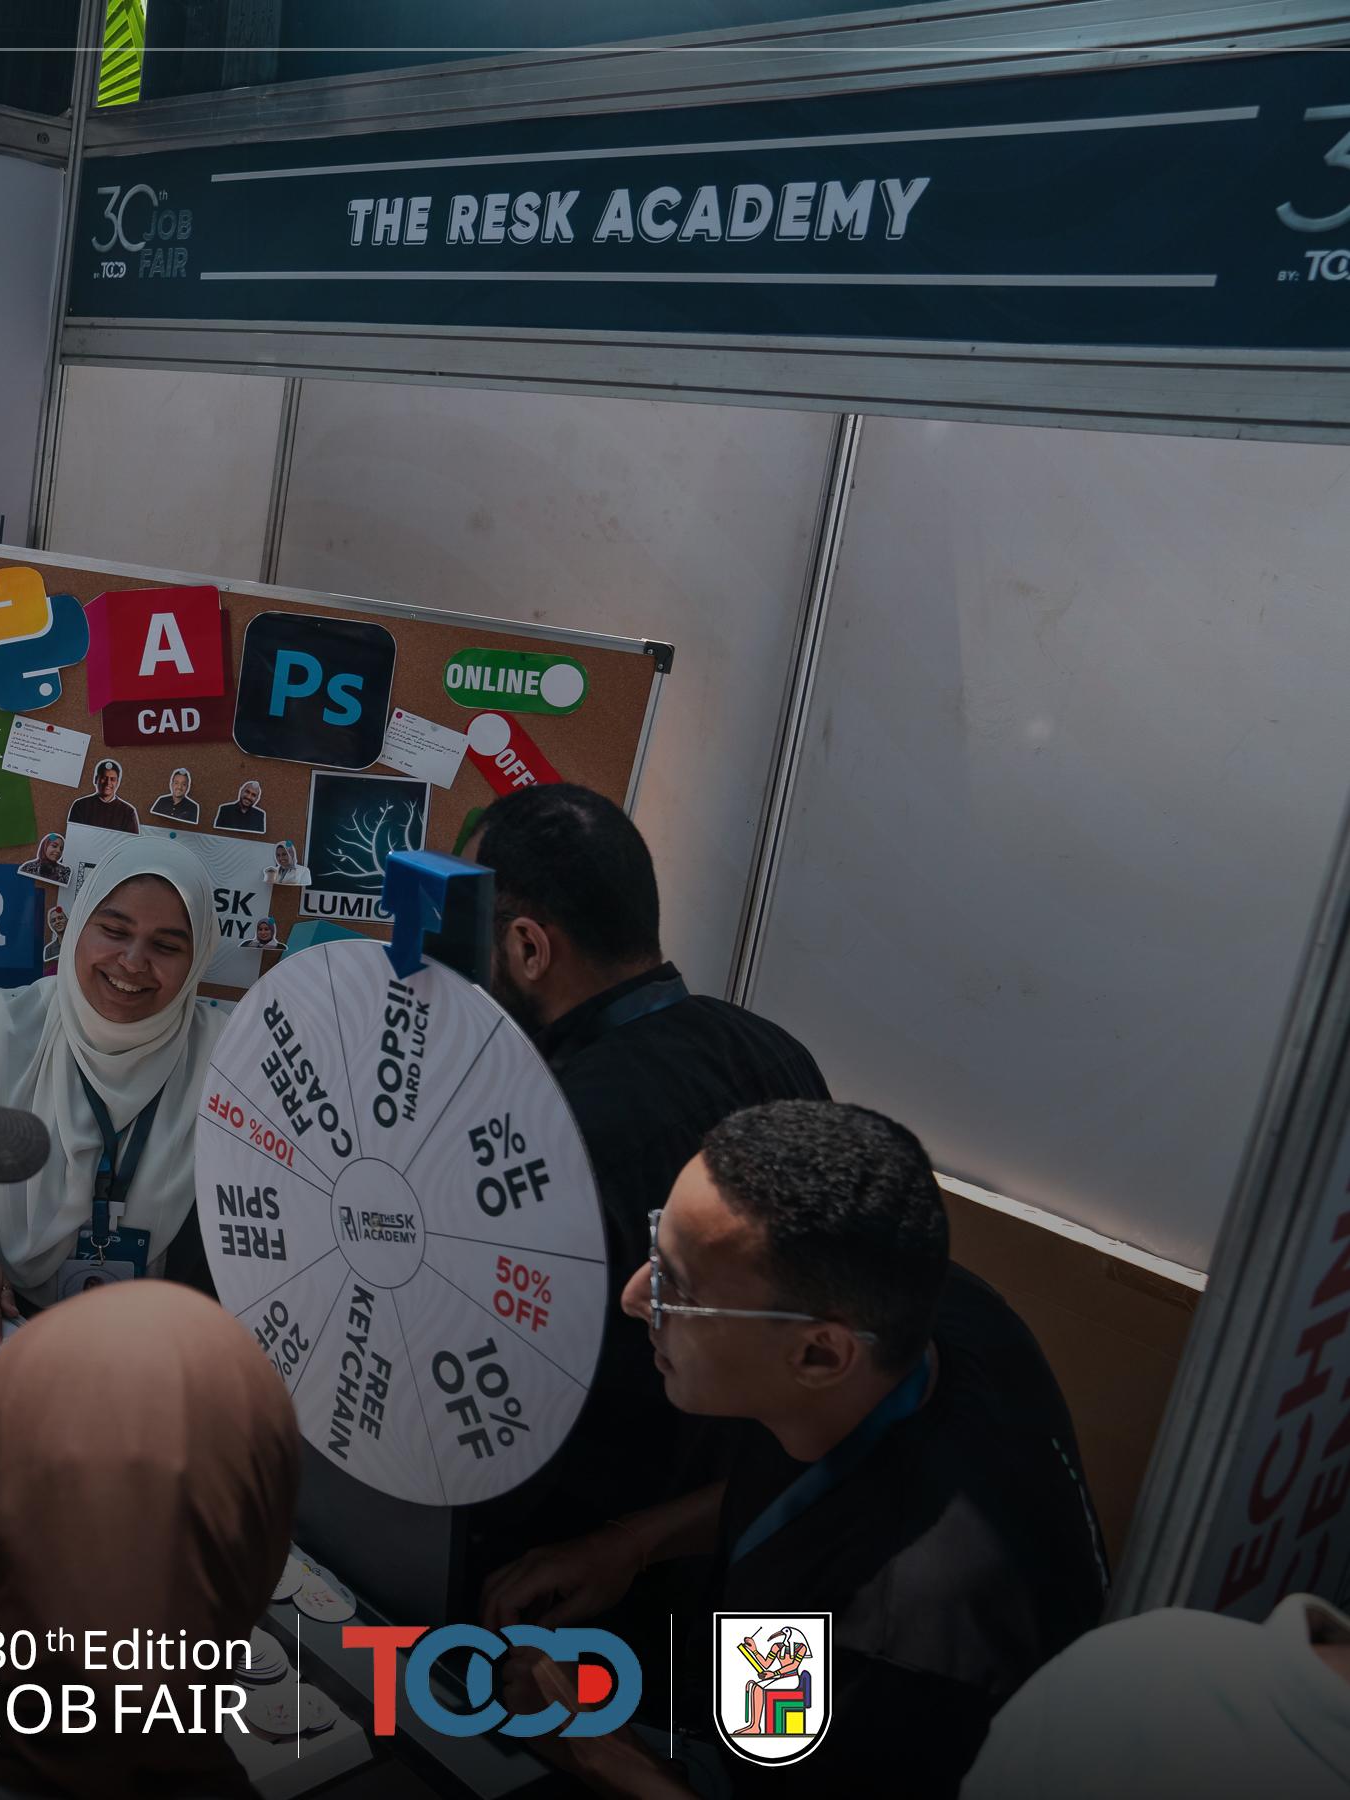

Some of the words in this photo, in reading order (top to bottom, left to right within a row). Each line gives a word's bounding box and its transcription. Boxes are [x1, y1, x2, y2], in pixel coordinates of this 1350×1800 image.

[142, 209, 193, 241] JOB
[348, 196, 432, 245] THE
[446, 190, 580, 245] RESK
[593, 177, 931, 243] ACADEMY
[138, 247, 189, 279] FAIR
[138, 612, 195, 676] A
[271, 649, 364, 727] Ps
[446, 663, 540, 696] ONLINE
[137, 707, 202, 735] CAD
[494, 748, 539, 788] OFF
[303, 892, 394, 922] LUMIO
[373, 979, 415, 1129] OOPS!!
[411, 1000, 430, 1059] LUCK
[260, 1050, 314, 1137] FREE
[263, 999, 352, 1158] COASTER
[402, 1062, 422, 1122] HARD
[207, 1093, 244, 1129] OFF
[249, 1118, 295, 1168] 100%
[468, 1112, 526, 1167] 5%
[215, 1184, 280, 1220] SPIN
[476, 1158, 550, 1217] OFF
[218, 1223, 287, 1261] FREE
[364, 1229, 417, 1244] ACADEMY
[495, 1255, 552, 1304] 50%
[254, 1300, 289, 1351] OFF
[493, 1289, 549, 1333] OFF
[328, 1284, 375, 1460] KEYCHAIN
[358, 1351, 392, 1440] FREE
[466, 1337, 531, 1447] 10%
[432, 1350, 495, 1459] OFF
